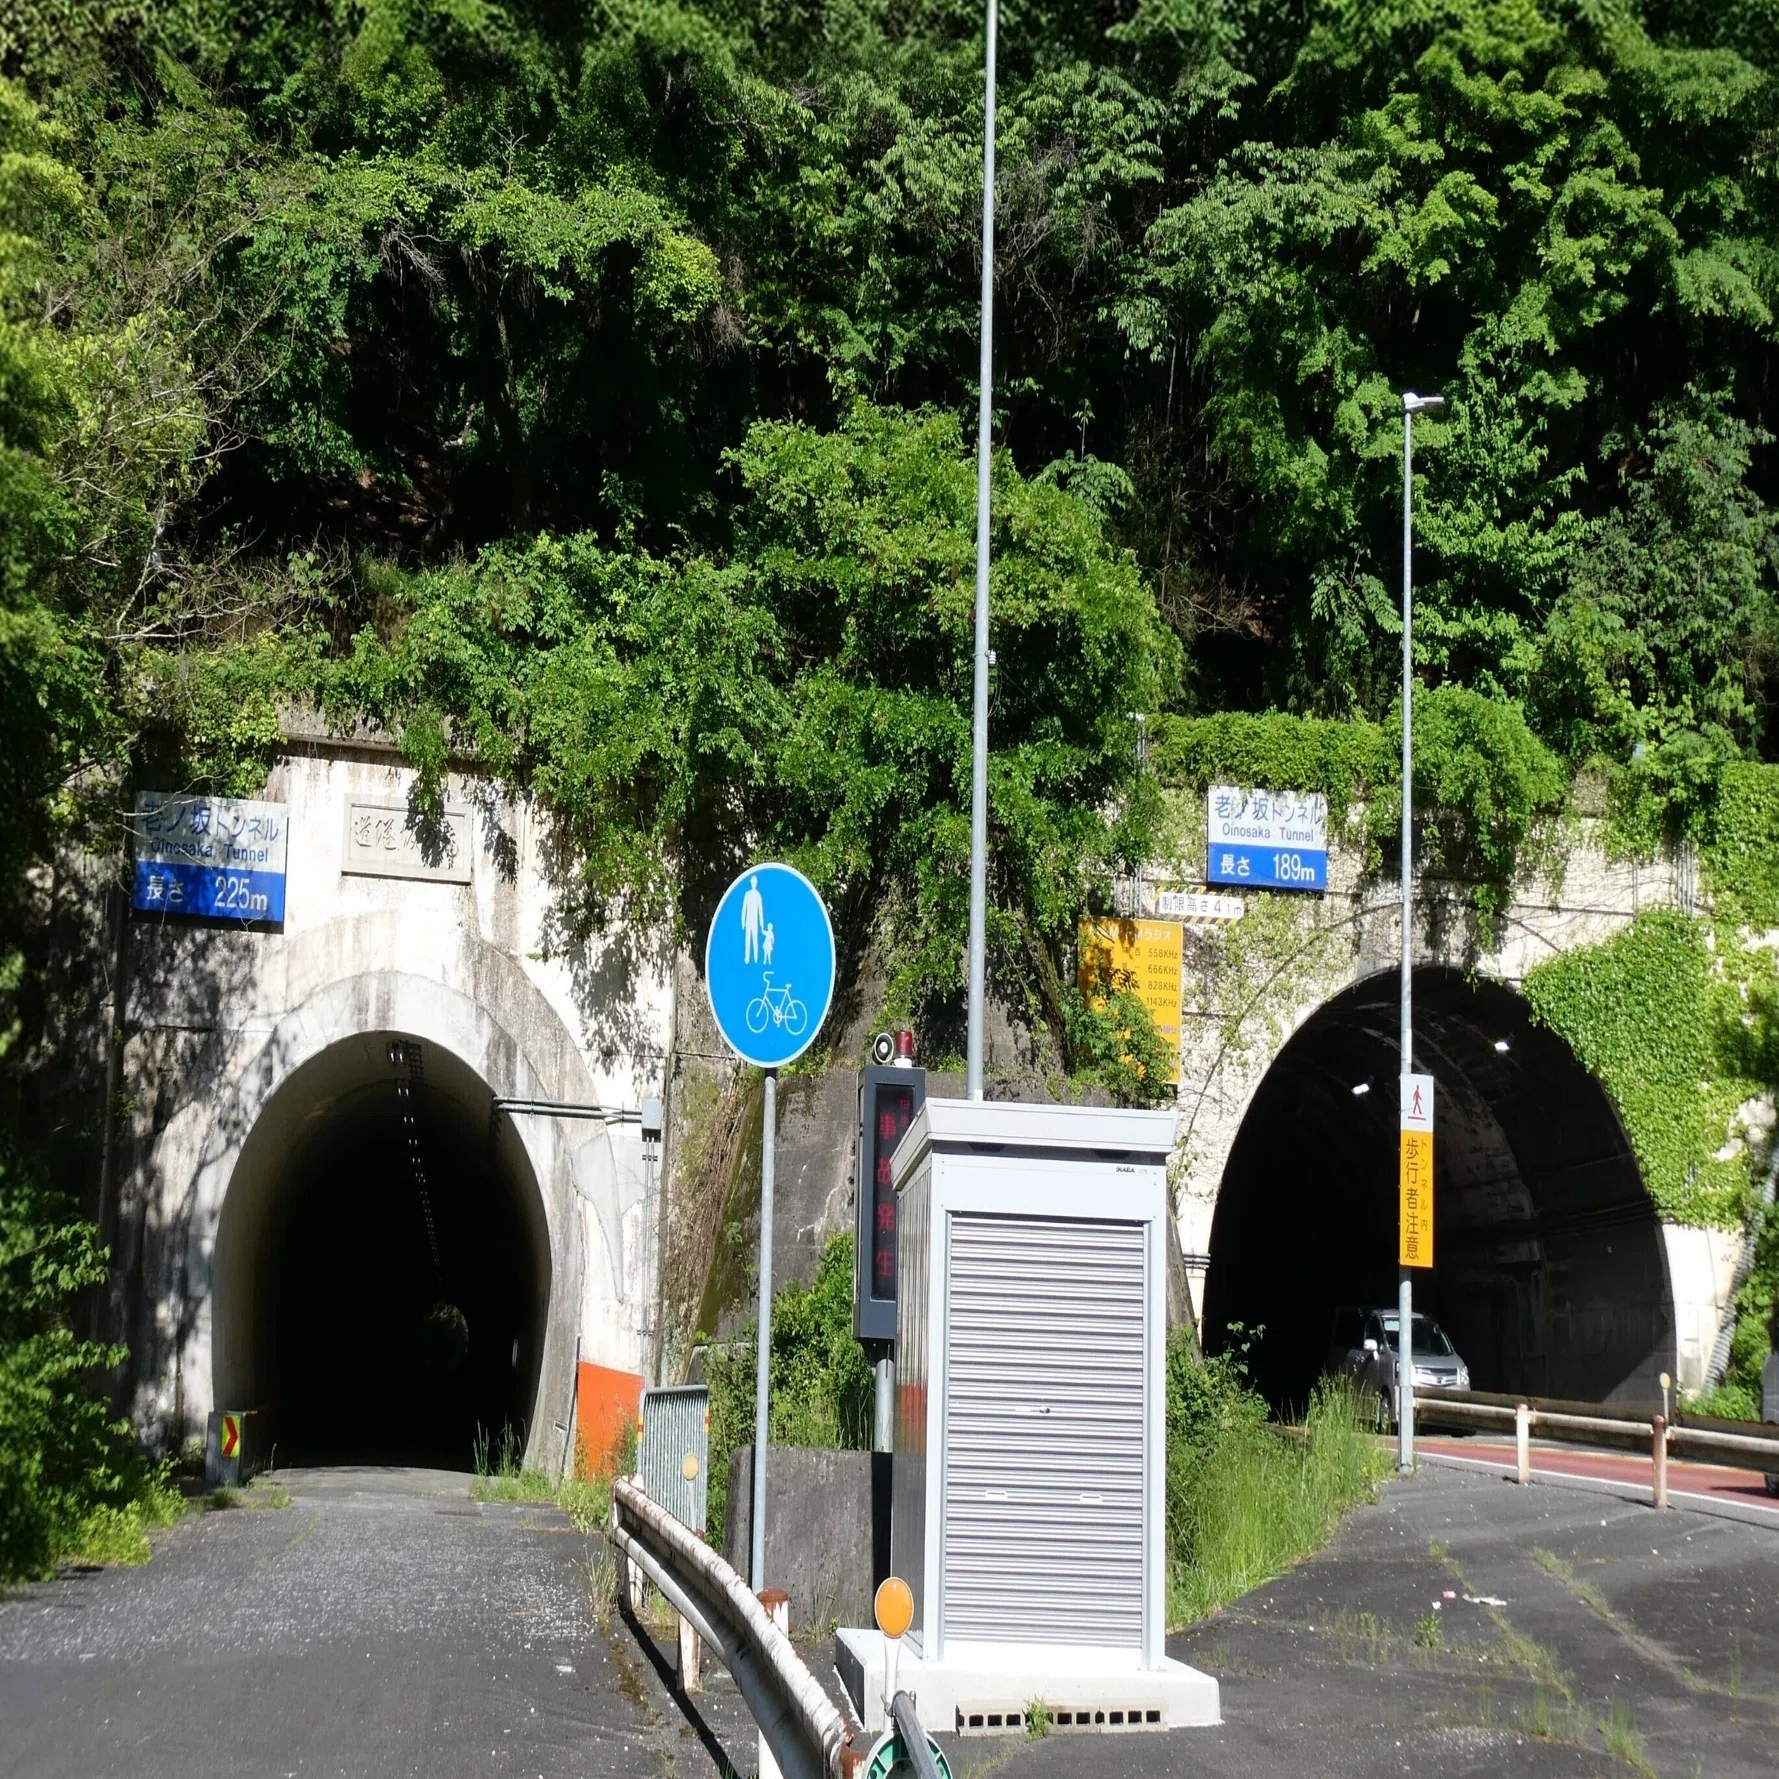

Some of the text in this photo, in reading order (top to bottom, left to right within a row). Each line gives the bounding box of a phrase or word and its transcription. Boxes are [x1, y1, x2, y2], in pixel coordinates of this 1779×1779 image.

[142, 801, 279, 842] 老ノ坂トンネル
[1215, 794, 1323, 826] 老ノ坂トンネル
[1222, 822, 1314, 842] Oinosaka Tunnel
[151, 836, 269, 863] Oinosaka Tunnel
[1220, 853, 1315, 882] 長さ 189m
[146, 875, 268, 911] 長さ 225m
[1148, 948, 1178, 960] 558KHz
[1147, 964, 1178, 975] 666KHz
[1147, 980, 1178, 992] 828KHz
[1146, 997, 1177, 1008] 1143KHz
[1405, 1136, 1419, 1260] 歩行者注意
[1420, 1137, 1429, 1232] トンネル内
